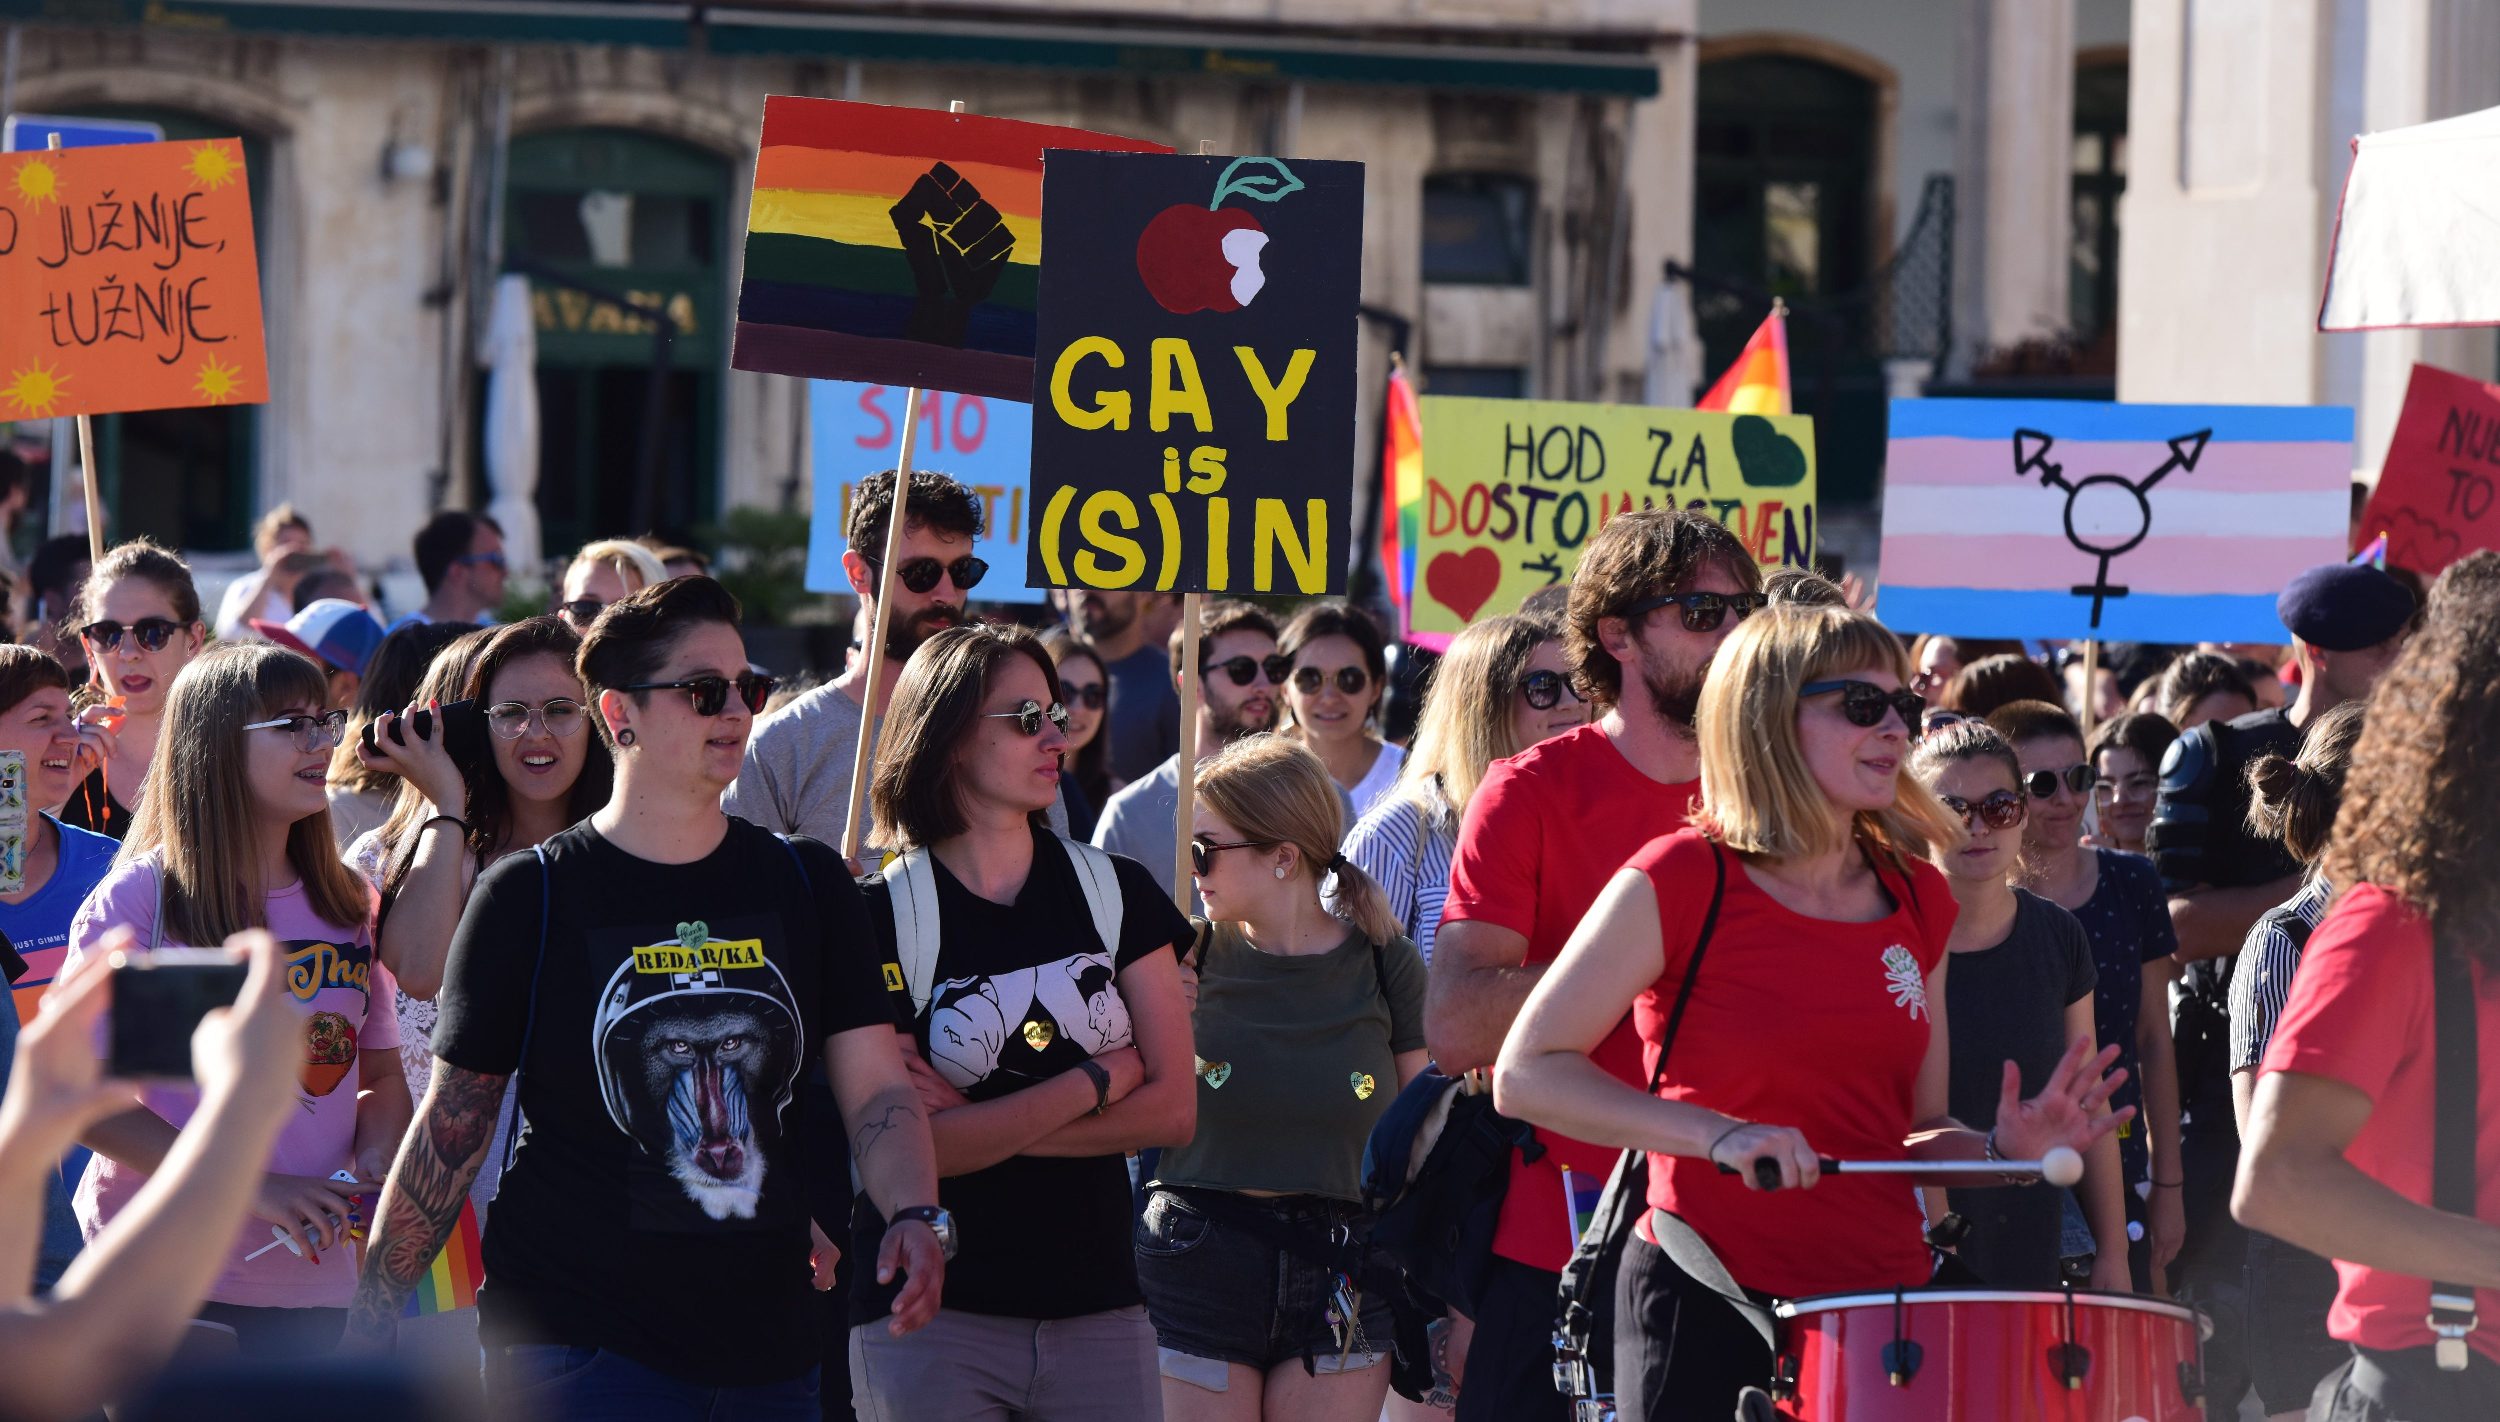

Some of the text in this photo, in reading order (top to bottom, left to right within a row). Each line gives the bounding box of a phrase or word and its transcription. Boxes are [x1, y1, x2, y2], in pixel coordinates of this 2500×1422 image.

[37, 189, 226, 270] JUŽNIJE,
[1050, 336, 1316, 441] GAY
[1504, 422, 1710, 492] HOD ZA
[2446, 468, 2494, 522] TO
[1040, 484, 1328, 595] (S)IN
[14, 934, 67, 950] JUST GIMME
[637, 946, 759, 969] REDAR/KA
